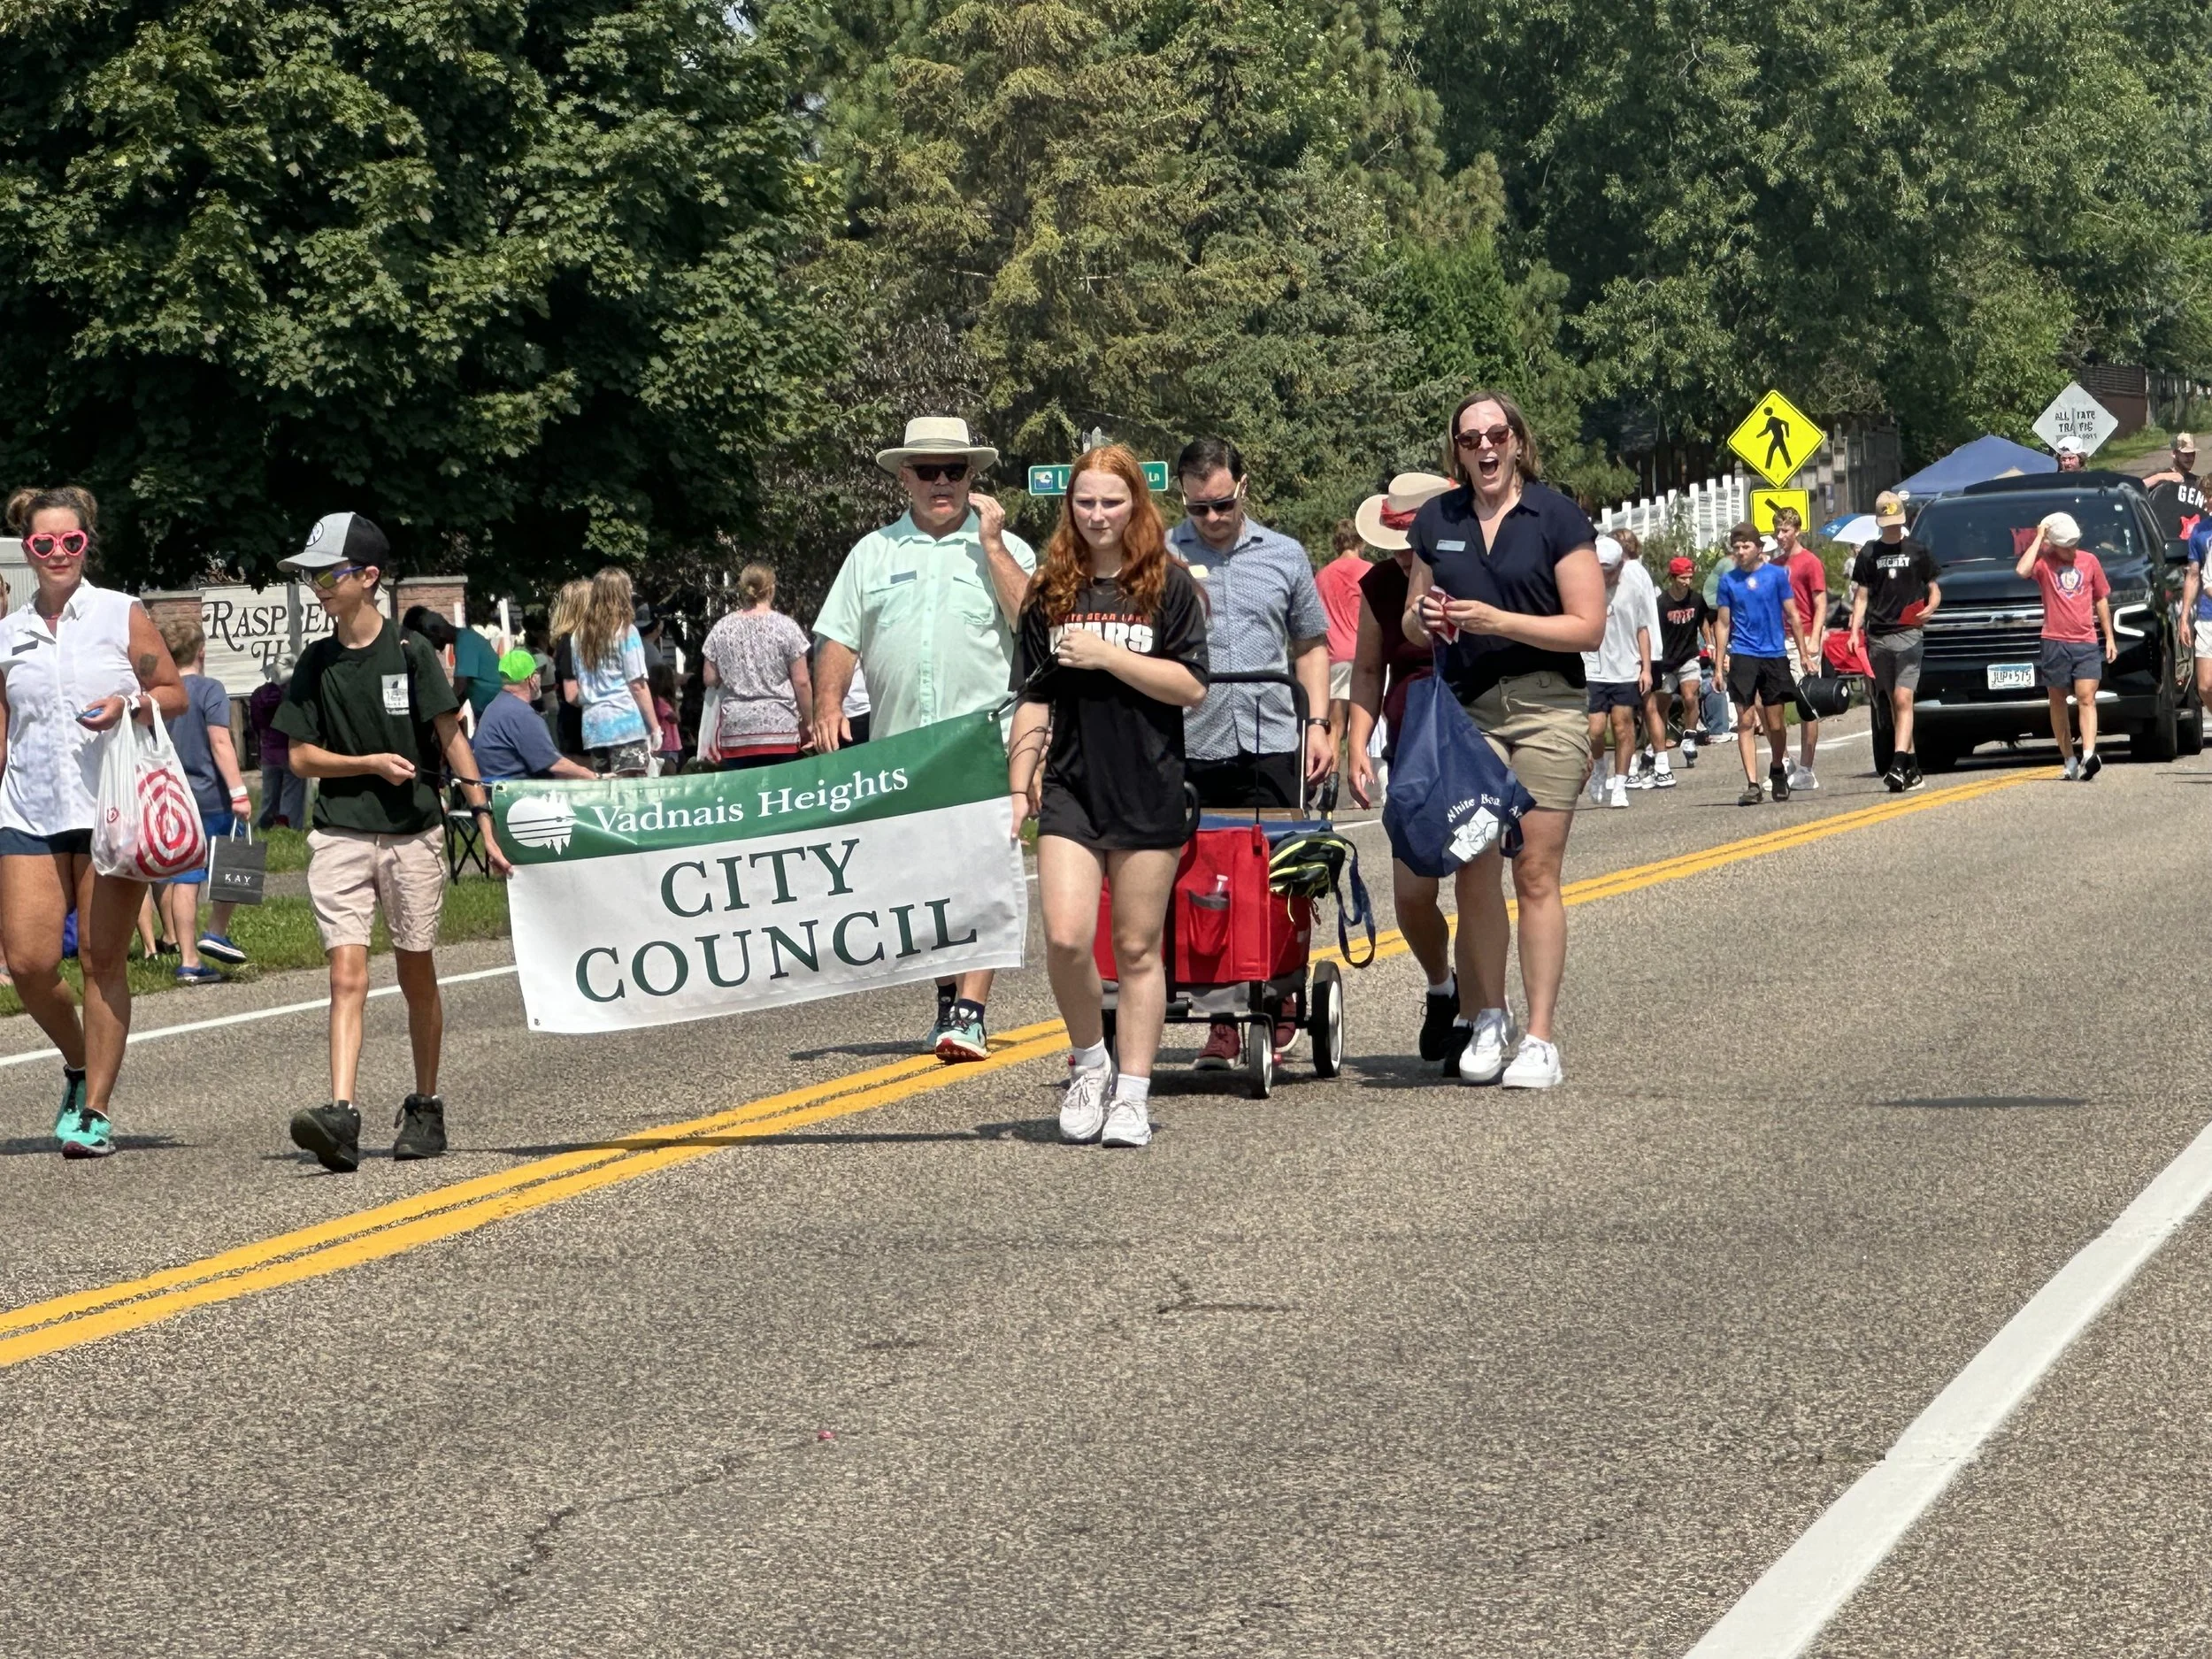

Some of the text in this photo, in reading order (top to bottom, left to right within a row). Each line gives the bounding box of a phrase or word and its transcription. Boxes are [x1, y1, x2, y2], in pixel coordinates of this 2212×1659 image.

[1148, 472, 1160, 482] Ln
[591, 764, 909, 833] Vadnais Heights
[225, 873, 251, 886] KAY
[660, 838, 860, 918] CITY
[576, 897, 977, 1002] COUNCIL
